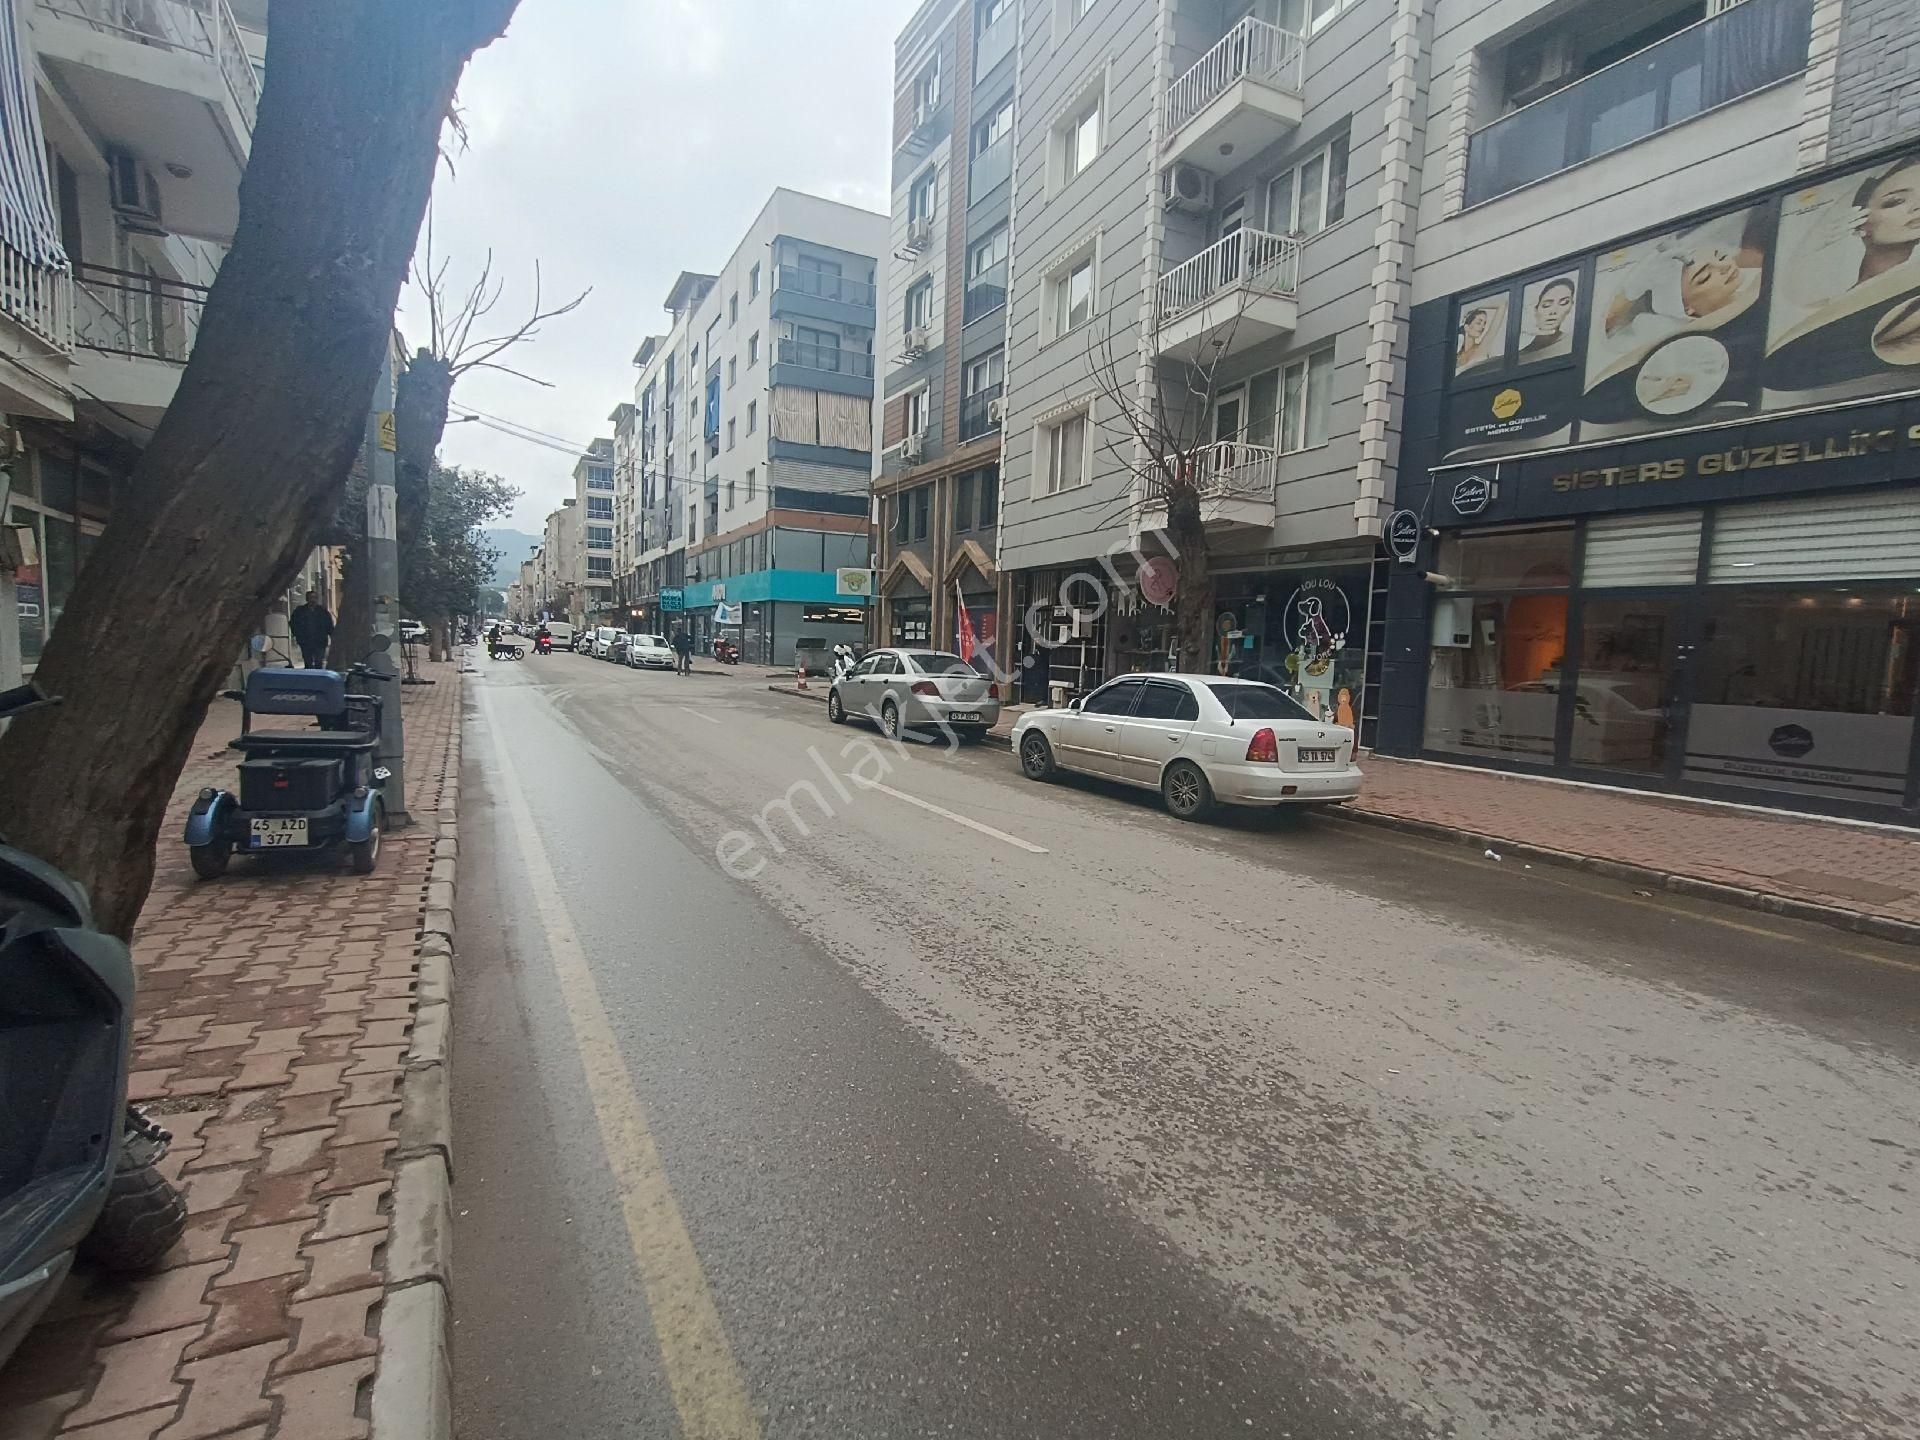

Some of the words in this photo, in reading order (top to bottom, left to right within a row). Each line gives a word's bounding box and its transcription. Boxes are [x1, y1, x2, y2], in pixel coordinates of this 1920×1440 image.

[1301, 579, 1317, 592] LOU
[1318, 579, 1336, 591] LOU
[253, 819, 270, 831] 45
[280, 818, 307, 831] AZD
[267, 833, 293, 846] 377
